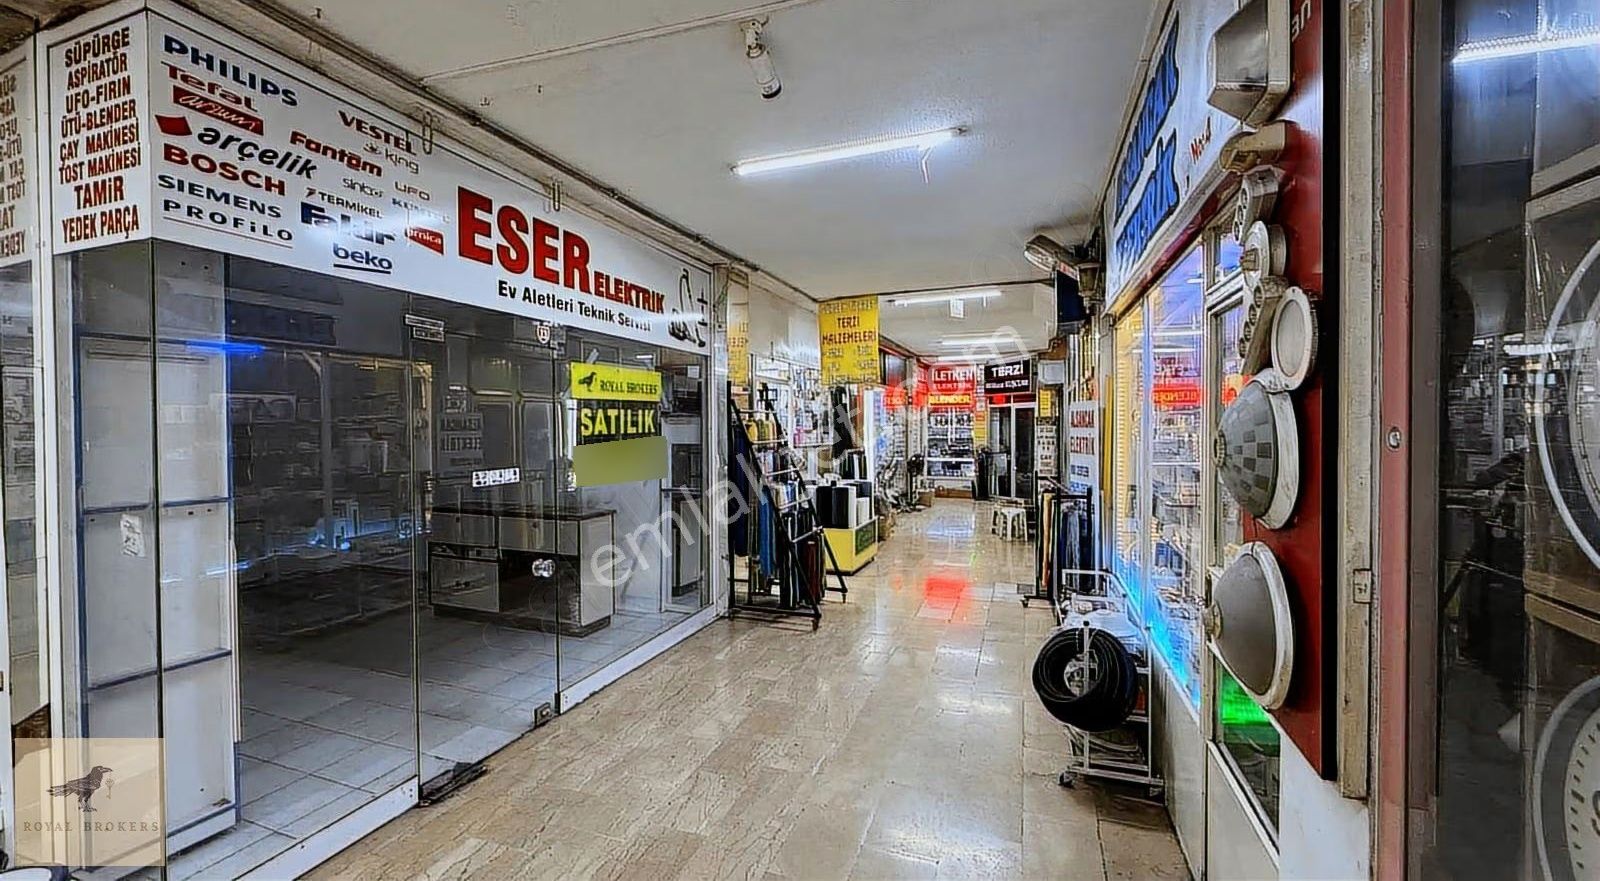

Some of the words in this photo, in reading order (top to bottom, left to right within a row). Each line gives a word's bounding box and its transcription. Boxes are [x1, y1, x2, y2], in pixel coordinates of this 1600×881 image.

[65, 26, 130, 68] SÜPÜRGE
[67, 52, 127, 91] ASPİRATÖR
[160, 61, 258, 112] Tefal
[164, 34, 298, 107] PHILIPS
[65, 75, 131, 113] UFO-FIRIN
[179, 95, 256, 130] arzum
[61, 99, 136, 138] ÜTÜ-BLENDER
[338, 110, 417, 156] VESTEL
[59, 161, 84, 184] TOST
[88, 141, 141, 177] MAKİNESİ
[60, 139, 79, 167] ÇAY
[86, 117, 140, 152] MAKİNESİ
[197, 127, 319, 179] arçelik
[290, 131, 382, 177] Fantom
[385, 148, 419, 174] king
[163, 142, 285, 196] BOSCH
[158, 174, 281, 218] SIEMENS
[395, 181, 430, 201] UFO
[62, 212, 97, 243] YEDEK
[101, 204, 139, 240] PARÇA
[333, 243, 392, 269] beko
[458, 186, 591, 294] ESER
[594, 271, 665, 315] ELEKTRIK
[498, 280, 517, 299] Ev
[522, 287, 573, 313] Aletleri
[578, 301, 615, 324] Teknik
[600, 380, 624, 393] ROYAL
[627, 381, 658, 395] BROKERS
[581, 407, 655, 436] SATILIK
